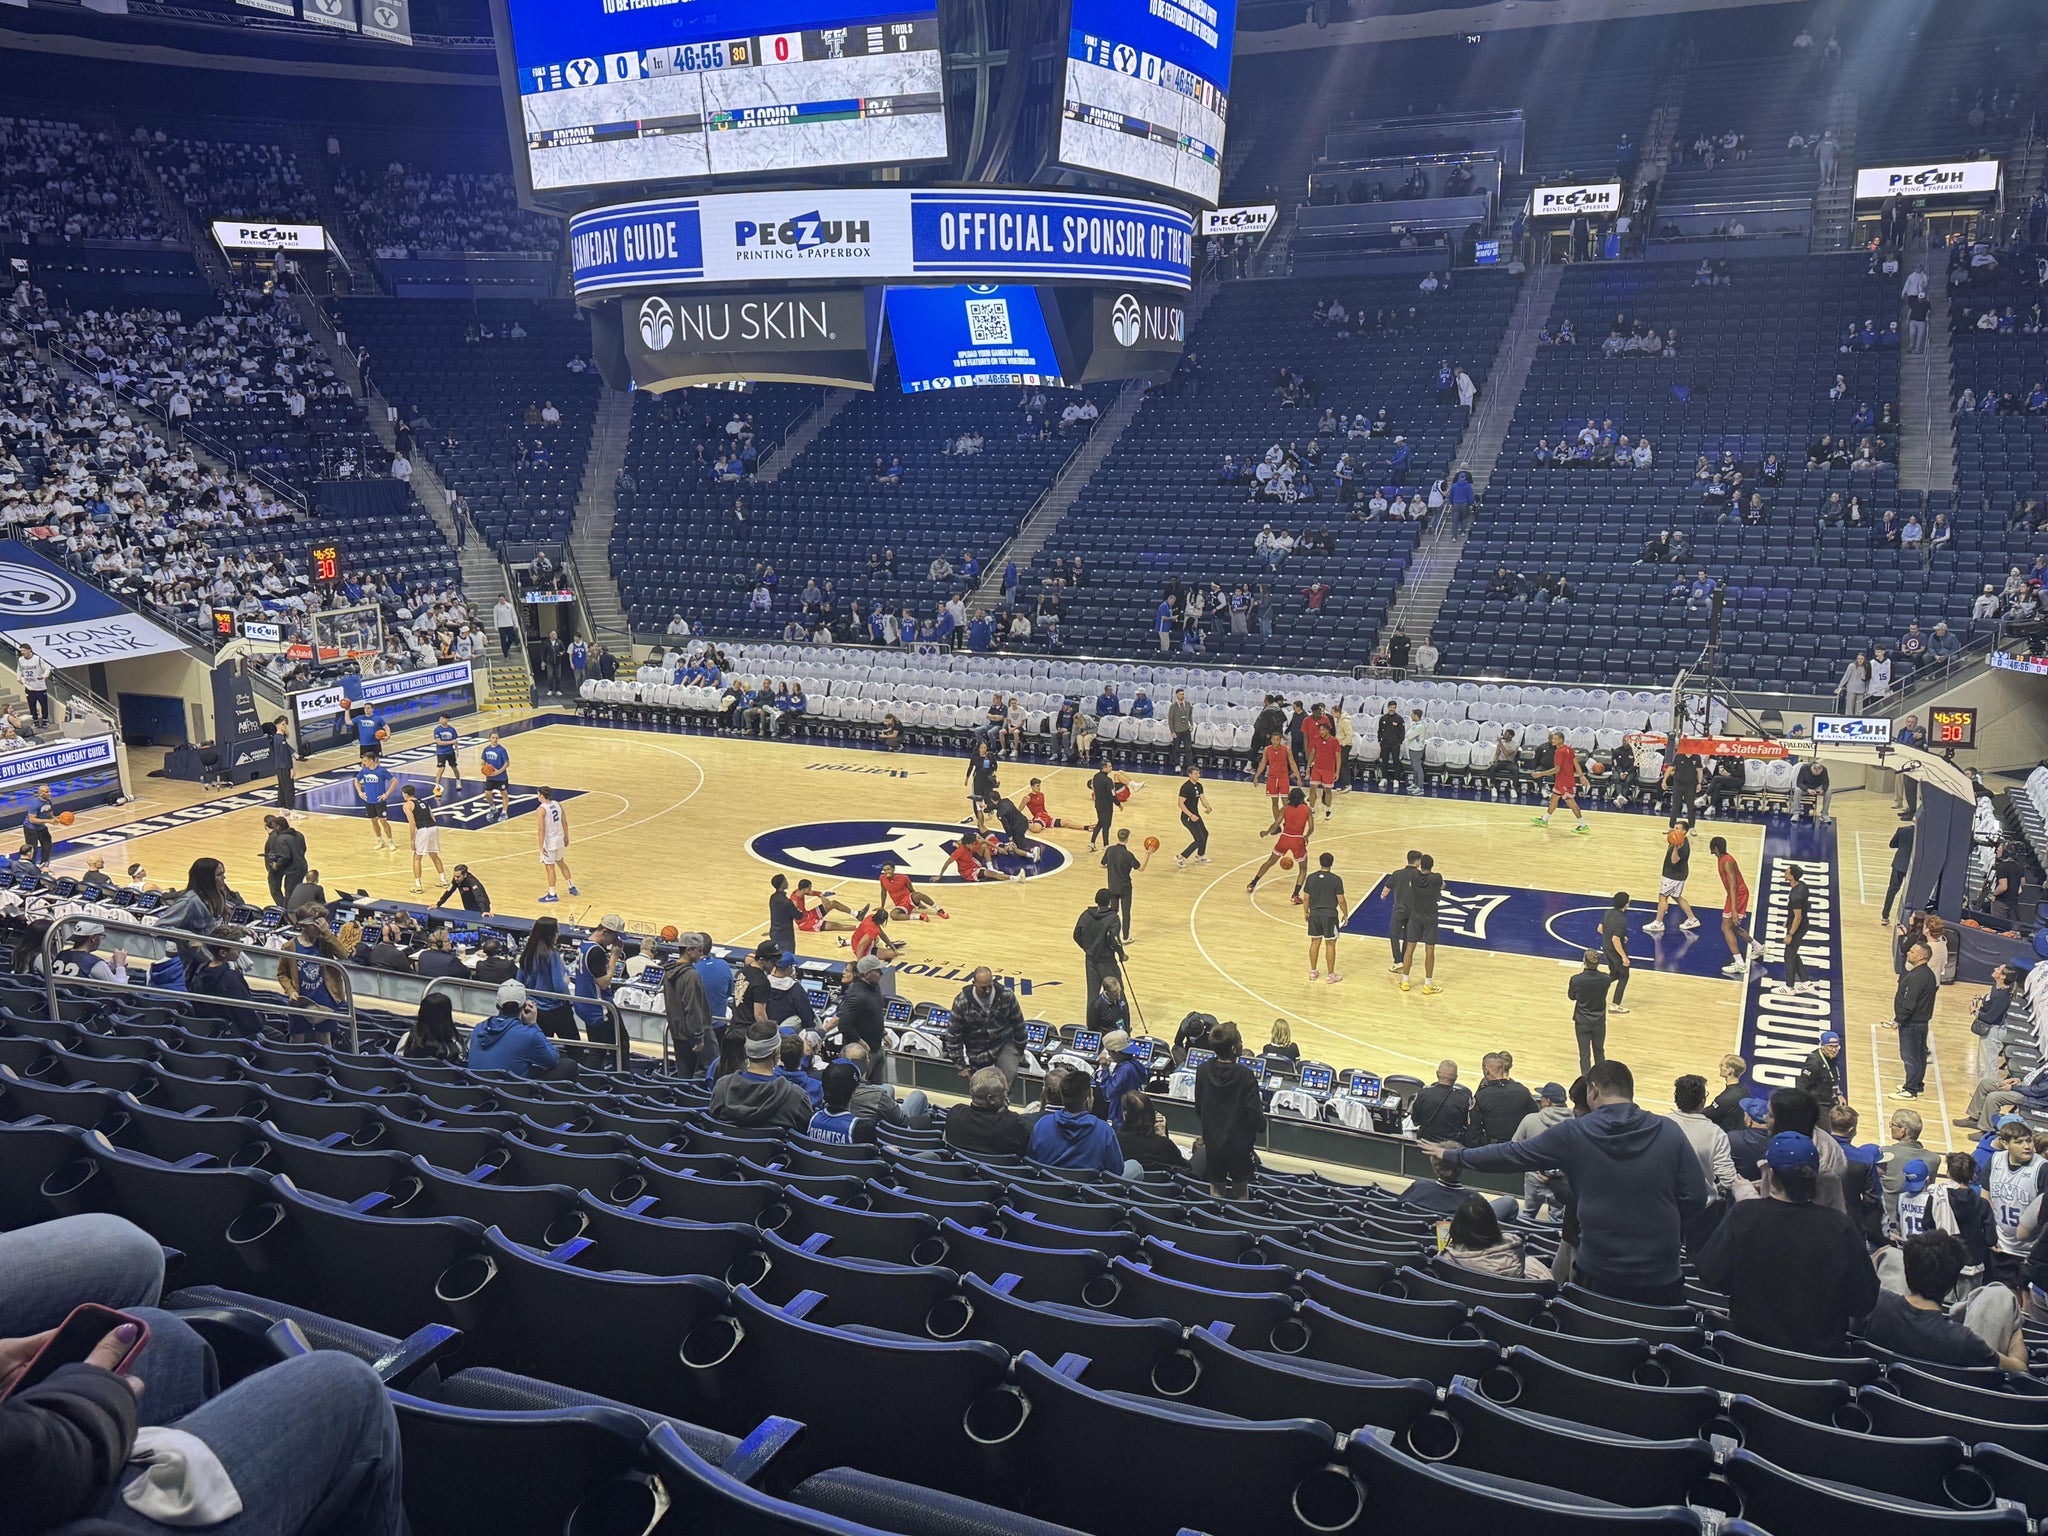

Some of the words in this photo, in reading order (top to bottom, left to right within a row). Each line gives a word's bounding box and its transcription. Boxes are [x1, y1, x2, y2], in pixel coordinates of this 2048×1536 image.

[630, 0, 679, 9] FEAT
[891, 24, 914, 35] FOULS
[774, 37, 789, 61] 0
[898, 35, 908, 51] 0
[673, 43, 724, 72] 46:55
[732, 46, 746, 62] 30
[616, 56, 628, 79] 0
[1147, 58, 1155, 80] 0
[1175, 68, 1194, 97] 46:55
[623, 221, 678, 262] GUIDE
[940, 212, 1054, 252] OFFICIAL
[1062, 215, 1145, 258] SPONSOR
[1150, 224, 1165, 260] OF
[1167, 227, 1182, 263] THE
[736, 249, 794, 260] PRINTING
[807, 247, 871, 259] PAPERBOX
[681, 304, 730, 341] NU
[741, 301, 828, 340] SKIN
[1144, 305, 1167, 340] NU
[960, 377, 966, 385] 0
[988, 375, 1010, 384] 46:55
[313, 547, 336, 560] 46:55
[317, 559, 336, 580] 30
[32, 624, 132, 647] ZIONS
[219, 622, 231, 633] 30
[55, 636, 155, 660] BANK
[1997, 659, 2002, 667] 0
[2009, 661, 2029, 671] 46:55
[2036, 665, 2042, 673] 0
[365, 686, 386, 697] SPONSOR
[385, 685, 392, 694] OF
[392, 683, 401, 692] THE
[409, 676, 436, 689] BASKETBALL
[435, 671, 454, 683] GAMEDAY
[454, 668, 467, 678] GUIDE
[1879, 673, 1888, 681] 15
[1933, 712, 1971, 725] 46:55
[1941, 725, 1964, 742] 30
[1779, 741, 1817, 750] SPALDING
[2, 765, 16, 778] BYU
[16, 756, 57, 774] BASKETBALL
[57, 749, 88, 765] GAMEDAY
[88, 745, 107, 758] GUIDE
[551, 809, 560, 822] 2
[924, 957, 1024, 976] CETER
[2000, 1205, 2021, 1227] 15
